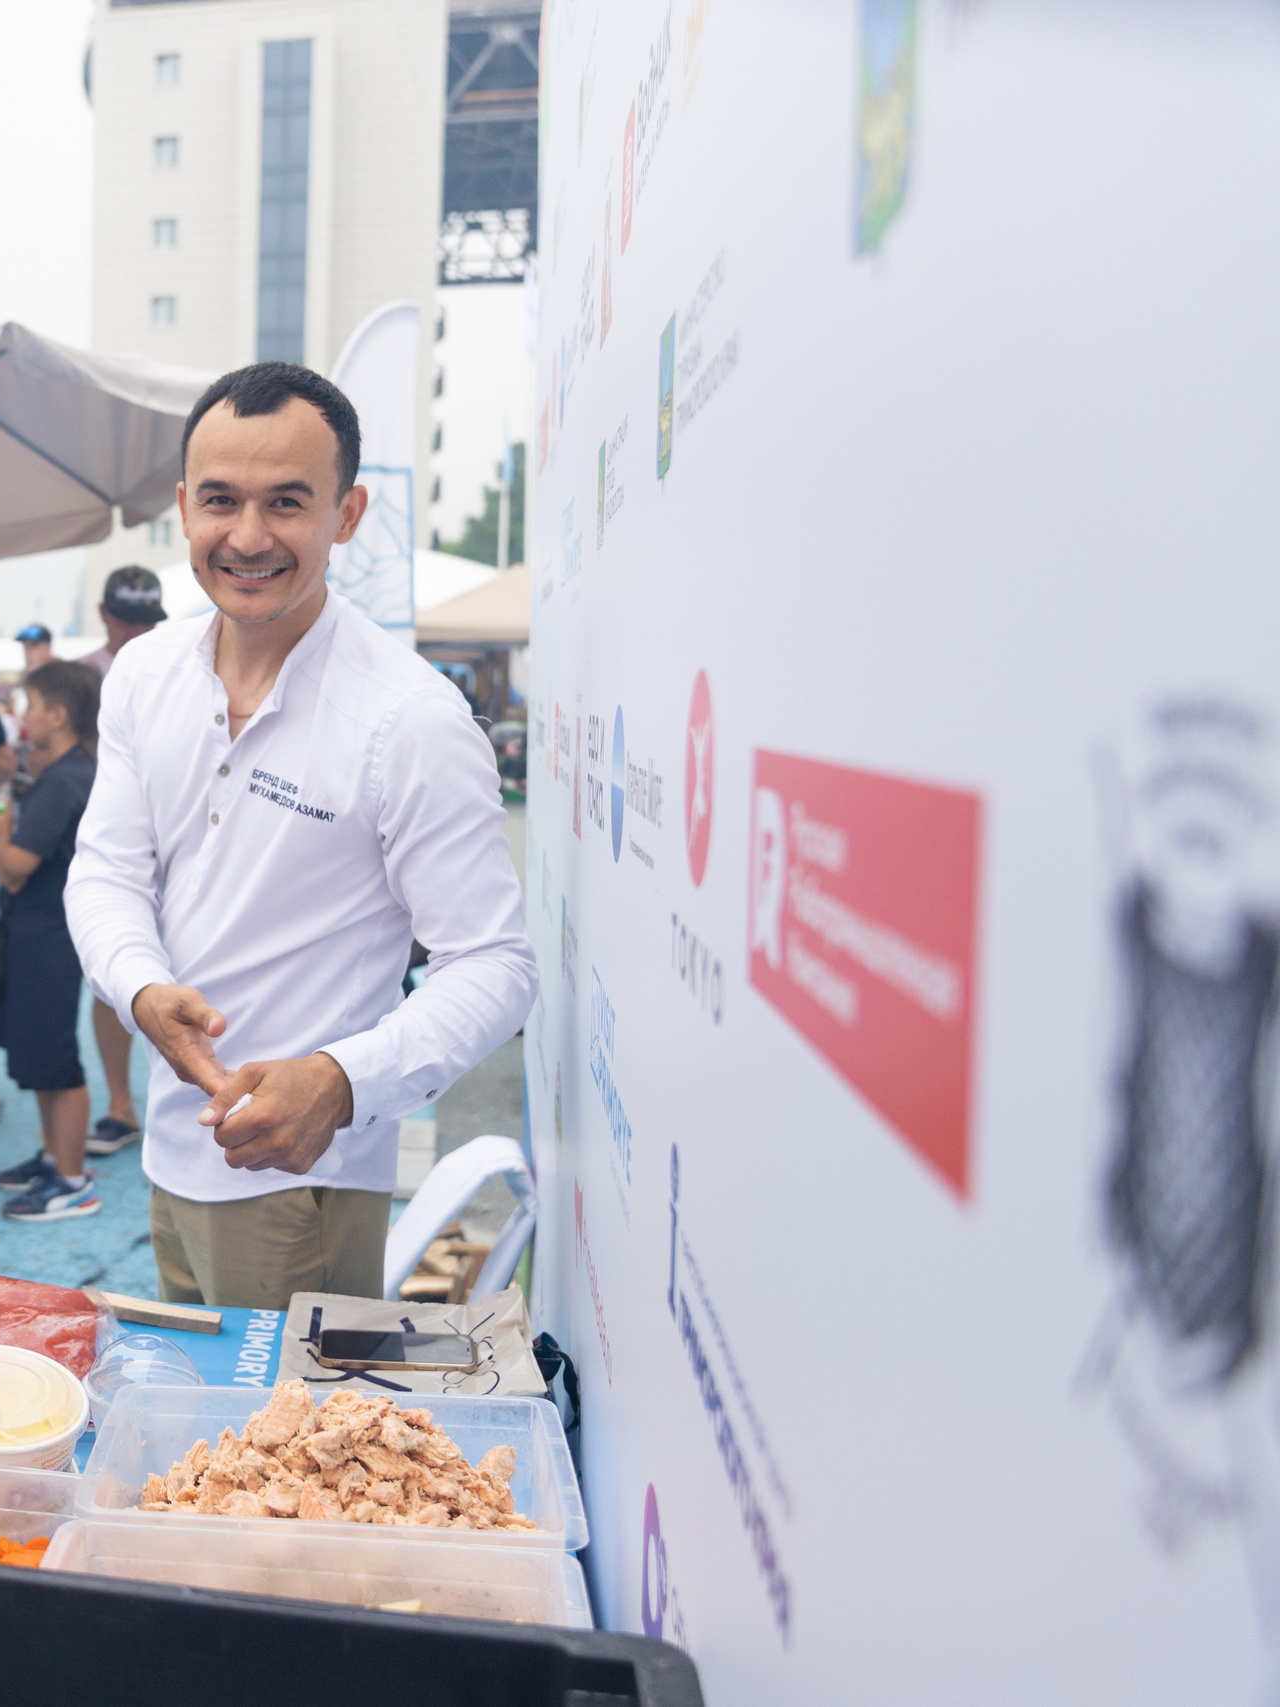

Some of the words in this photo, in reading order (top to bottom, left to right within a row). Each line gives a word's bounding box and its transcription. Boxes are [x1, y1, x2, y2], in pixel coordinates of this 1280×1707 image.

[249, 782, 296, 810] МУХАМЕДОВ
[295, 802, 336, 823] АЗАМАТ
[252, 769, 280, 789] БРЕНД
[279, 779, 299, 795] ШЕФ
[670, 911, 724, 1026] TOKYO
[600, 983, 616, 1062] VISIT
[598, 1045, 632, 1188] PRIMORYE
